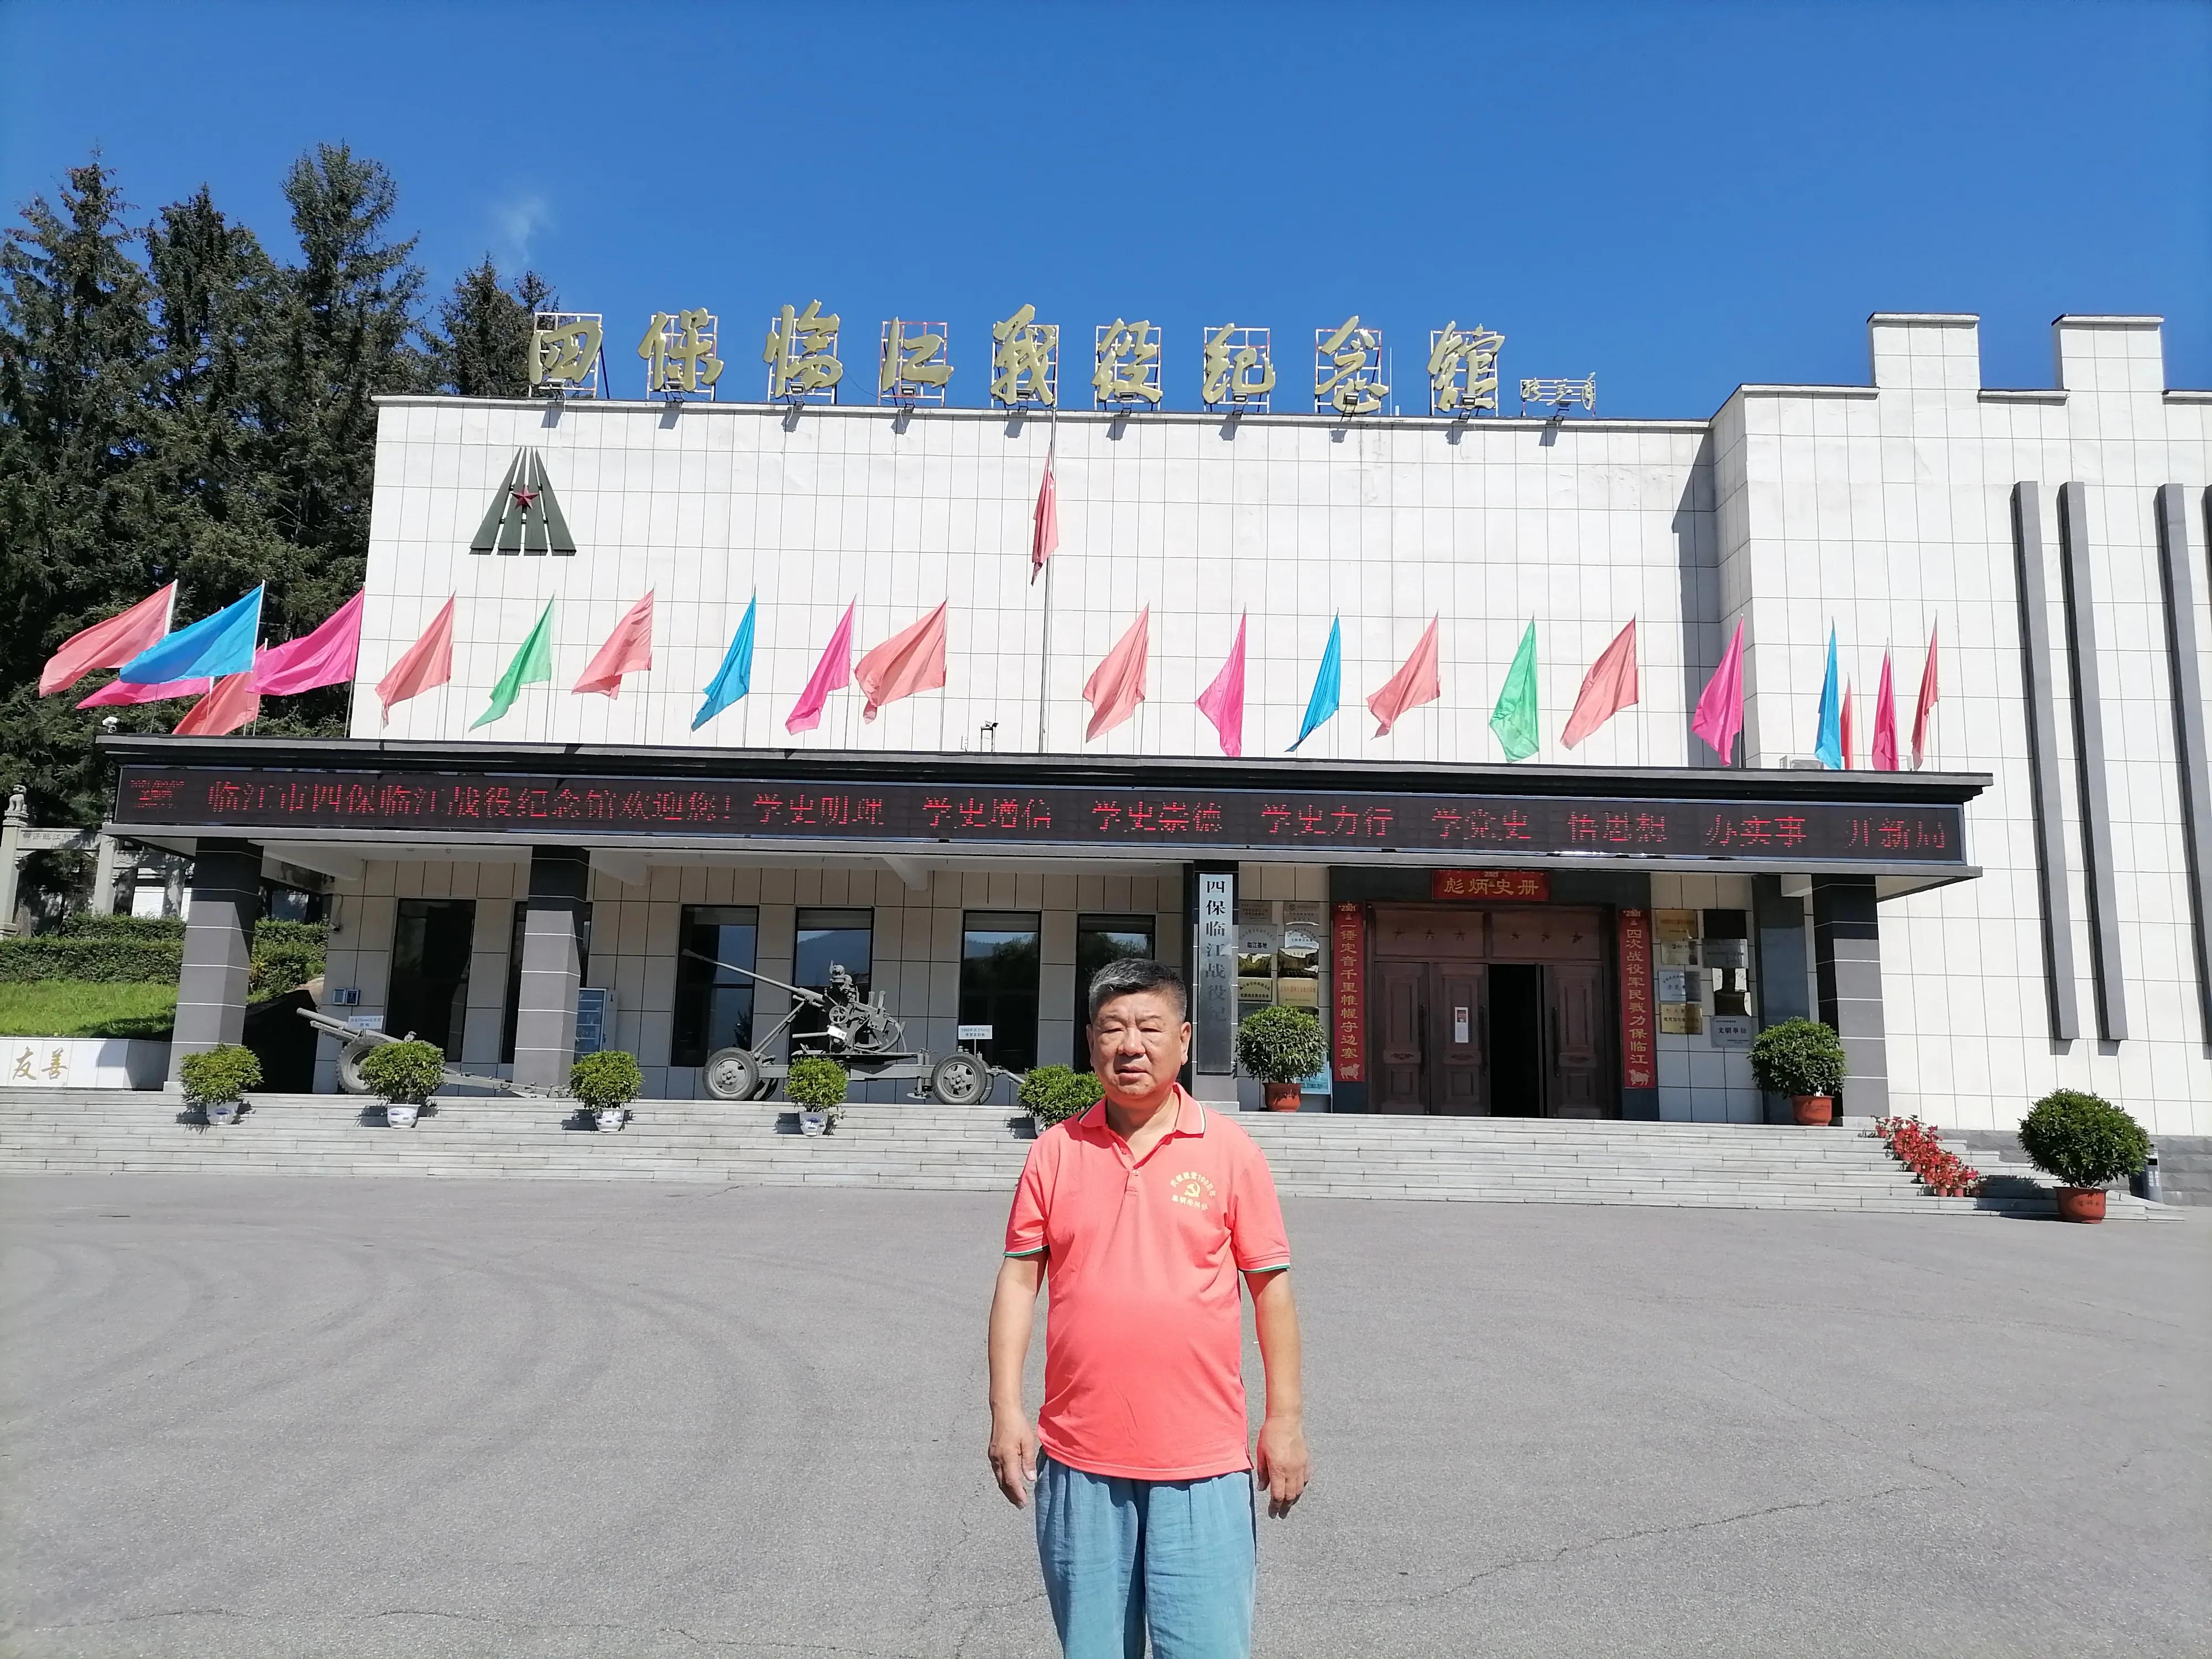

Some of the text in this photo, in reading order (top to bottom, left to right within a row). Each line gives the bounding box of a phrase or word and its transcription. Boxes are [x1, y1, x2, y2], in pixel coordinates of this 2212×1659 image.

[529, 299, 1505, 414] 四保临江战役纪念馆
[1444, 877, 1539, 895] 彪炳史册
[1340, 925, 1359, 1059] 一锤定音千里帷幄守边塞
[1626, 928, 1648, 1065] 四次战役军民戮力保临江
[12, 1046, 68, 1081] 友善
